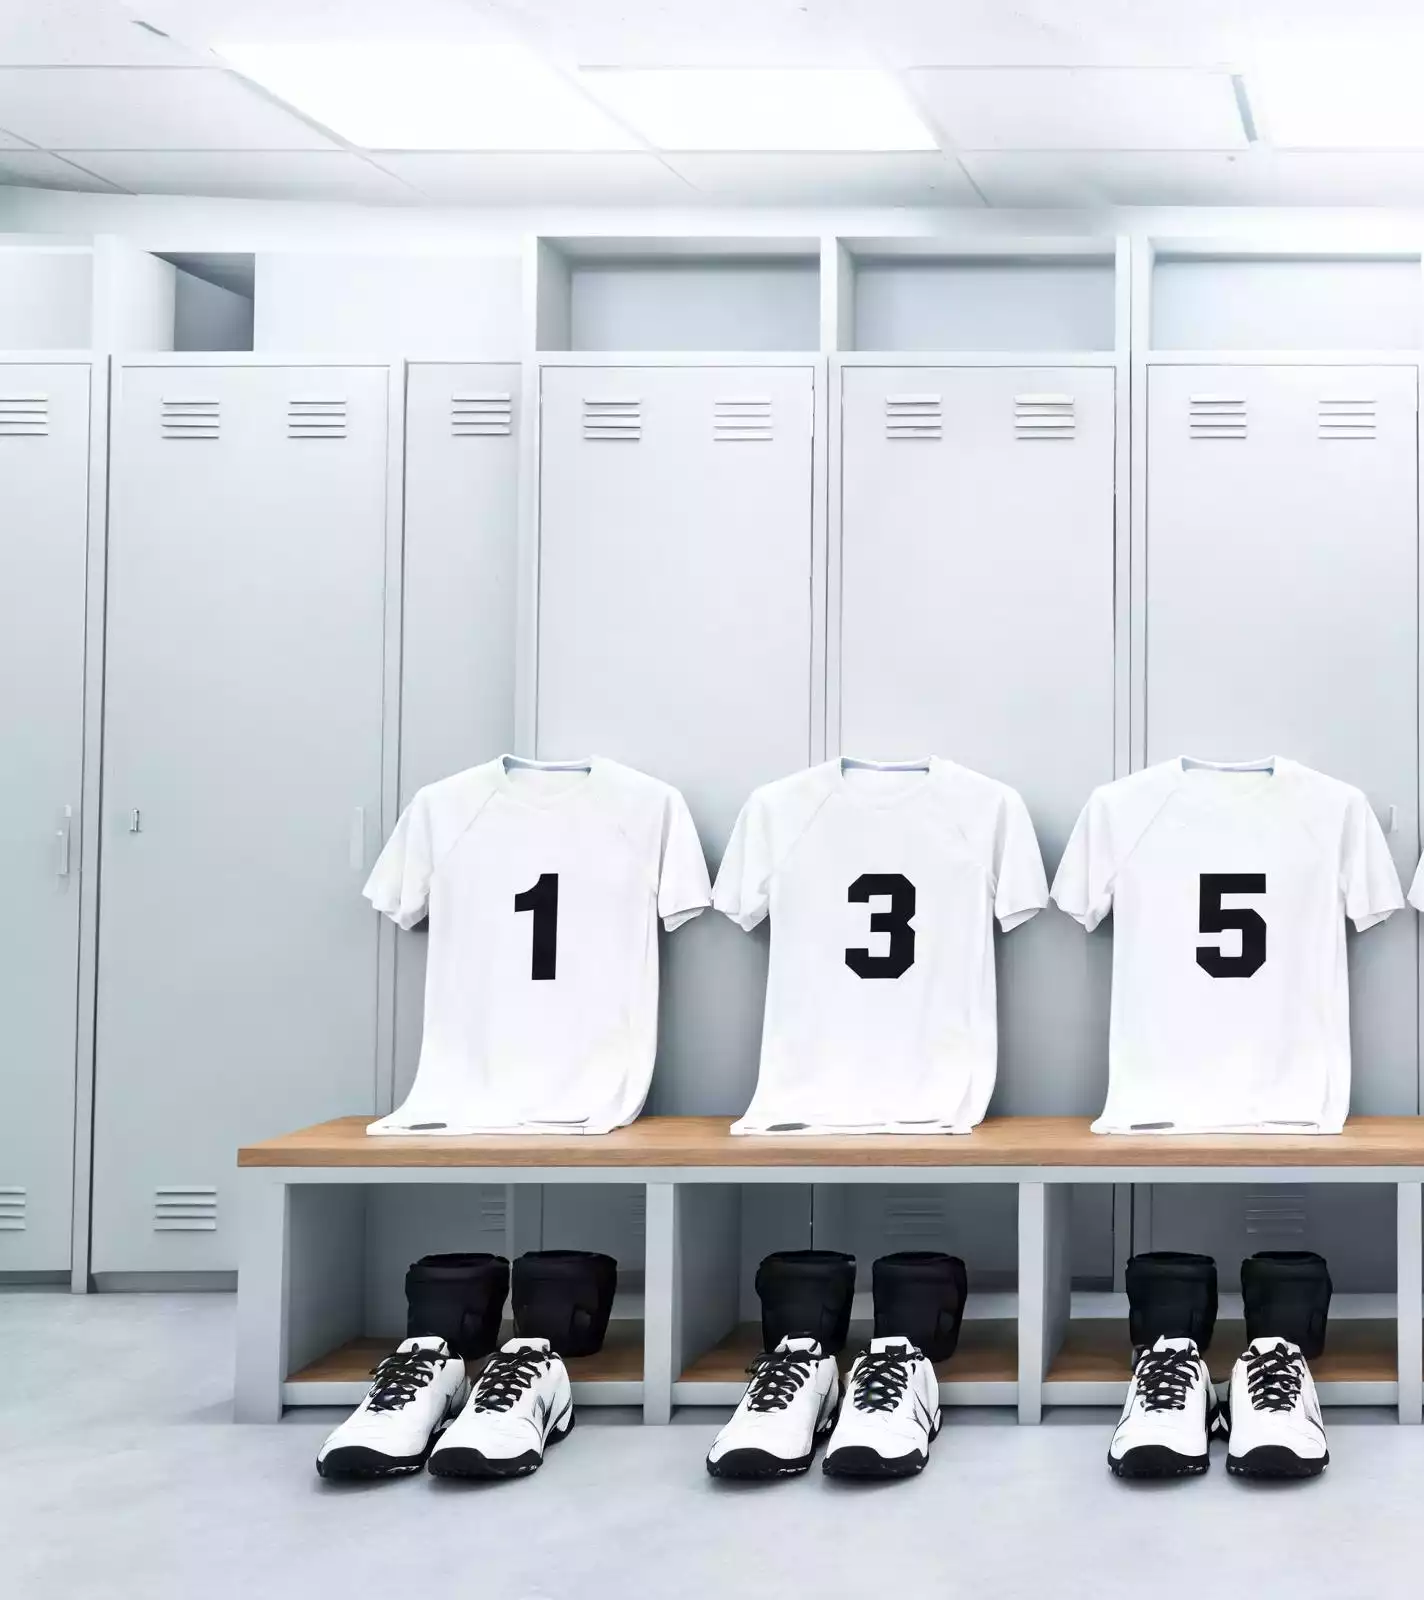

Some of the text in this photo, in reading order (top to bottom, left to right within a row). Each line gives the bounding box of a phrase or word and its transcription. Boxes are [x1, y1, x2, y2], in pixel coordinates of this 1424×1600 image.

[514, 872, 559, 981] 1
[844, 873, 916, 980] 3
[1195, 873, 1267, 979] 5
